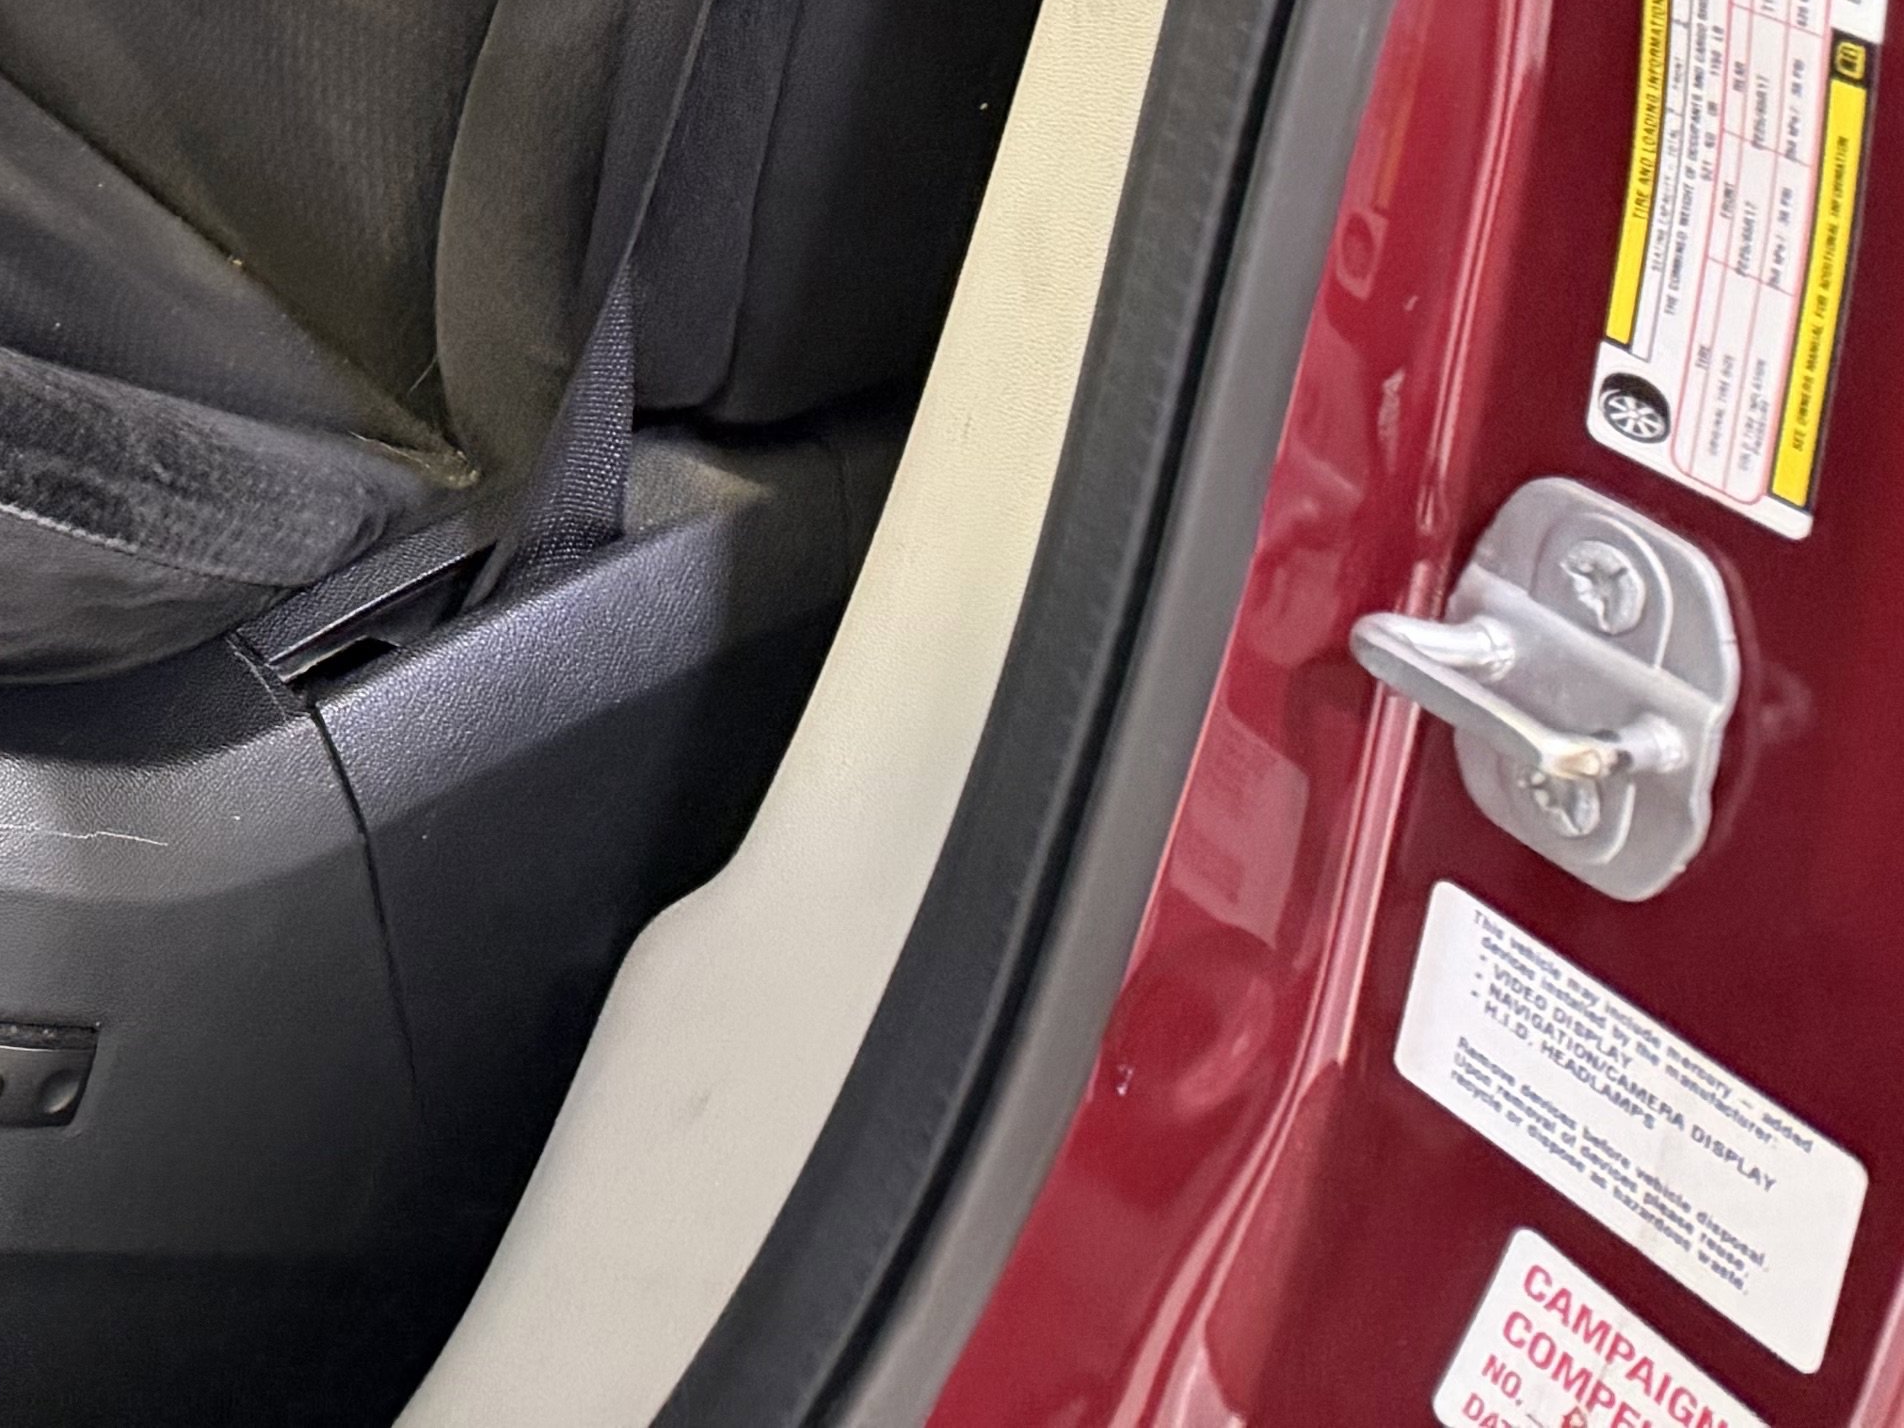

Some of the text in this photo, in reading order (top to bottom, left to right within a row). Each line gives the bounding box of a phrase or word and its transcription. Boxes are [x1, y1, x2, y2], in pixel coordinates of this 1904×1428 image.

[1636, 154, 1654, 187] AND
[1641, 91, 1660, 154] LOADING
[1631, 188, 1649, 222] TIRE
[1473, 911, 1503, 939] This
[1509, 936, 1561, 979] vehicle
[1566, 977, 1598, 1012] may
[1605, 1002, 1661, 1048] include
[1665, 1046, 1731, 1100] mercury
[1761, 1110, 1812, 1153] added
[1480, 935, 1534, 980] devices
[1540, 976, 1605, 1028] installed
[1611, 1025, 1629, 1048] by
[1635, 1041, 1659, 1066] the
[1492, 965, 1631, 1070] VIDEO DISPLAY
[1457, 1036, 1514, 1086] Remove
[1520, 1082, 1576, 1130] devices
[1582, 1126, 1630, 1169] before
[1635, 1164, 1691, 1213] vehicle
[1488, 983, 1774, 1193] NAVIGATION/CAMERA DISPLAY
[1540, 1040, 1655, 1130] HEADLAMPS
[1453, 1052, 1491, 1088] Upon
[1497, 1083, 1555, 1133] removal
[1560, 1128, 1575, 1147] of
[1580, 1143, 1637, 1192] devices
[1643, 1190, 1693, 1236] please
[1612, 1186, 1690, 1252] hazardous
